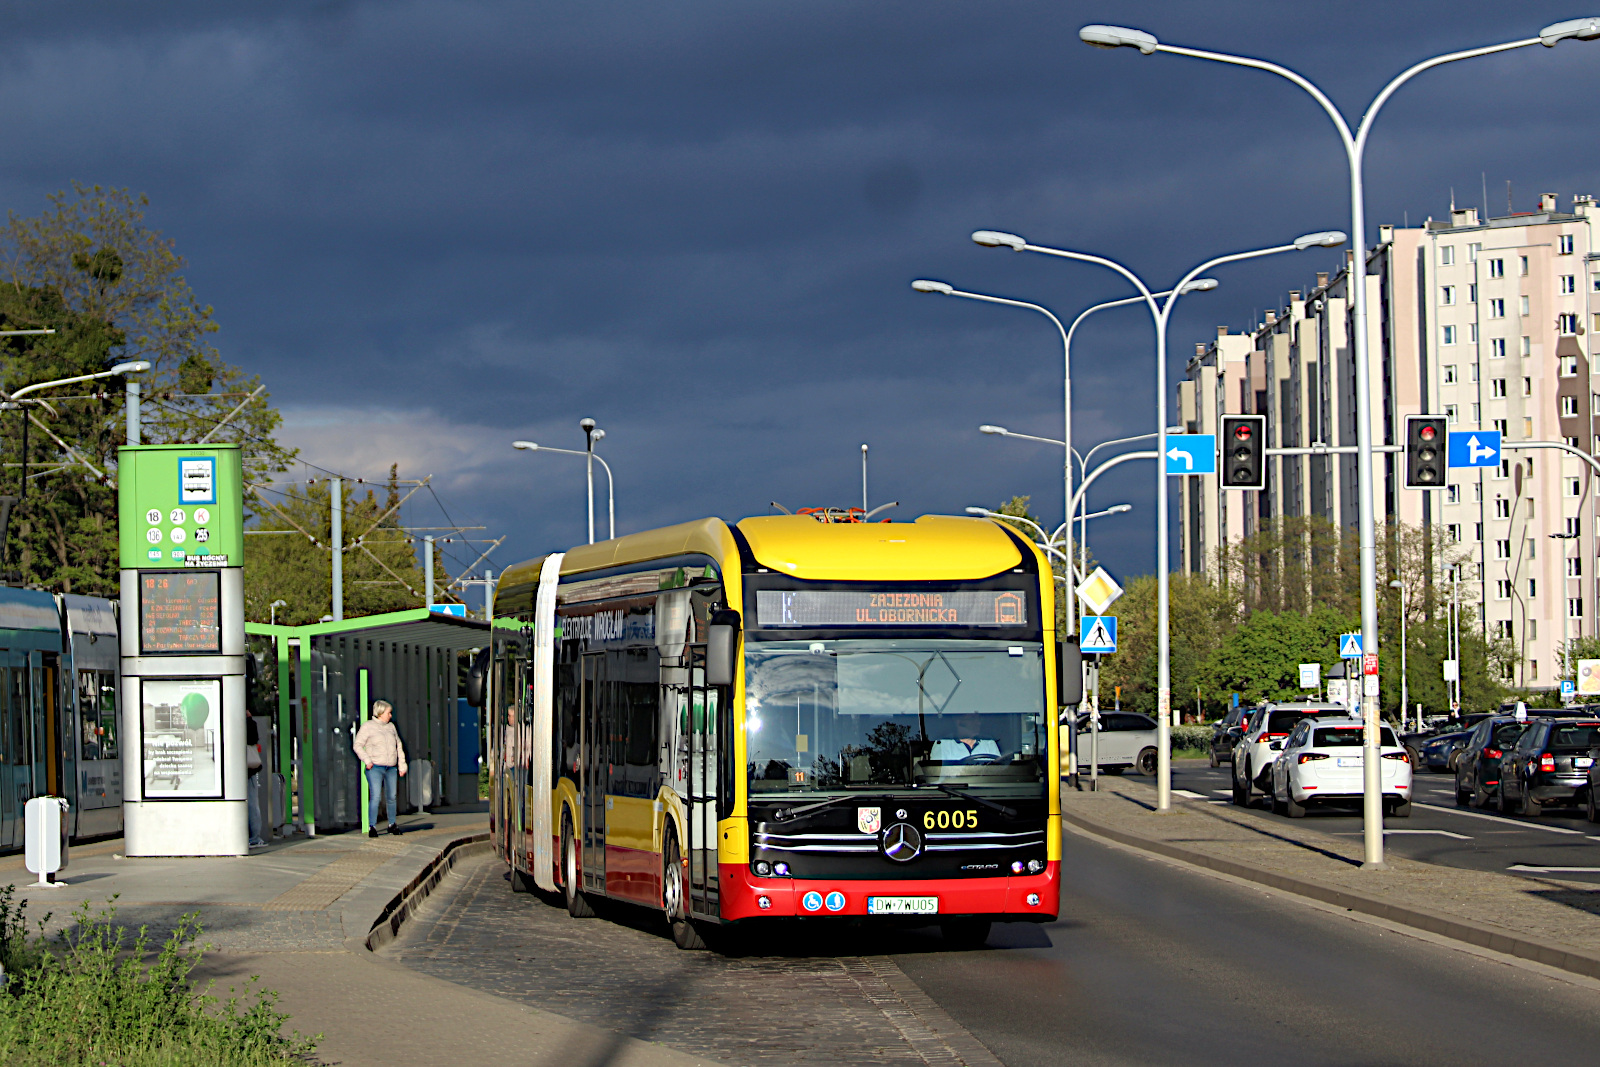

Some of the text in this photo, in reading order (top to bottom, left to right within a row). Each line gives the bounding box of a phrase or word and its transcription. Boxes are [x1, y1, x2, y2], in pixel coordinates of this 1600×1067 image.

[147, 511, 159, 522] 18
[171, 510, 184, 521] 21
[197, 511, 205, 522] K
[148, 530, 160, 541] 136
[869, 593, 943, 608] ZAJEZDNIA
[856, 608, 957, 623] UL. OBORNICKA
[594, 609, 624, 640] WROCŁAW
[1563, 682, 1572, 692] P
[794, 772, 804, 782] 11
[923, 809, 978, 830] 6005
[876, 899, 892, 912] DW
[897, 899, 935, 912] 7WU05
